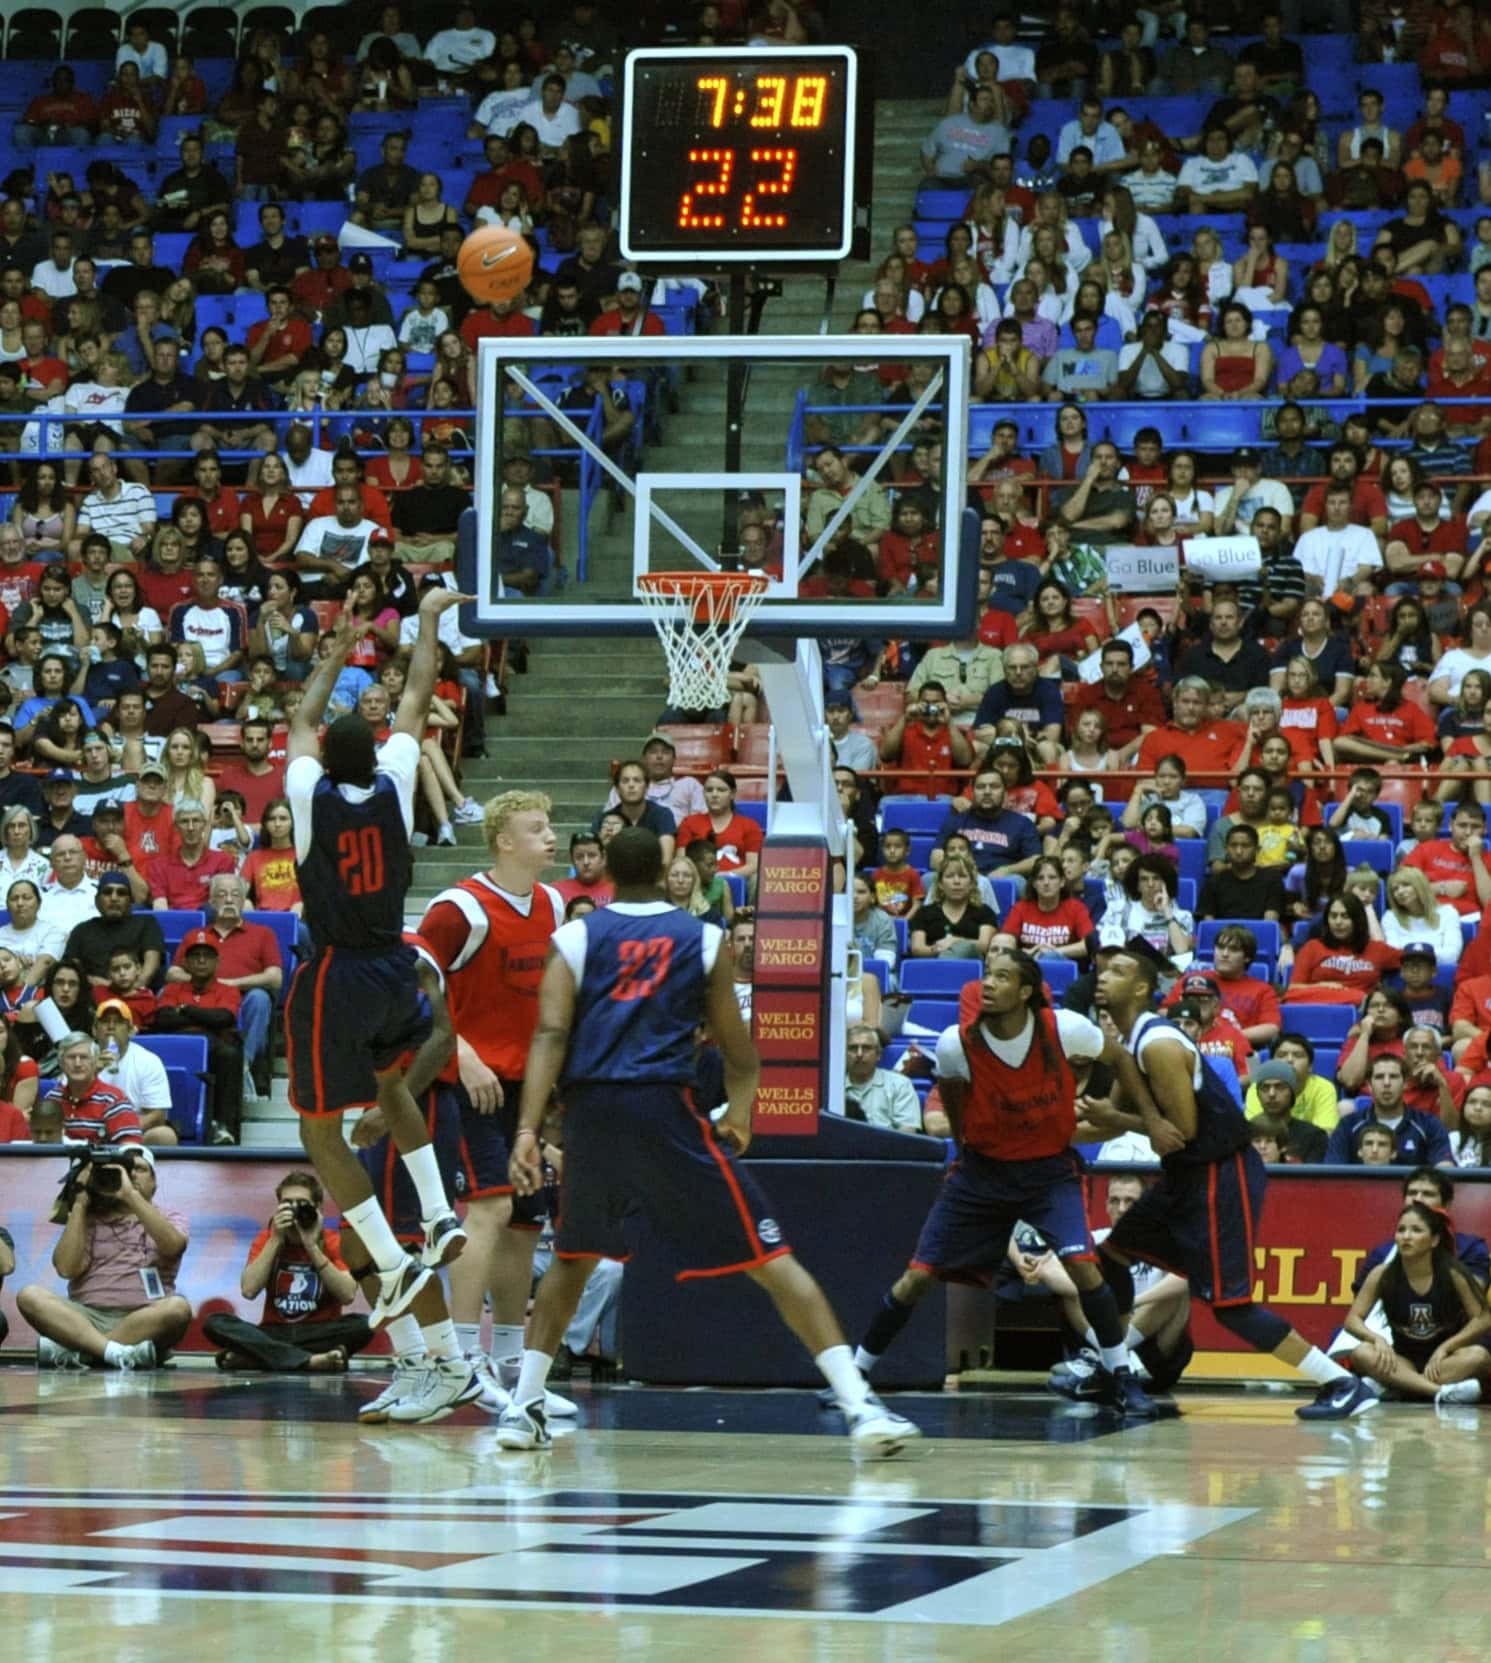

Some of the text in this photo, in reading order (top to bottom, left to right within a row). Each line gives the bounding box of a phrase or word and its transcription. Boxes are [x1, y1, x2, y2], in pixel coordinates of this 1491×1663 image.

[697, 77, 827, 128] 7:38
[678, 149, 797, 228] 22
[1188, 548, 1257, 567] Go Blue
[1109, 559, 1176, 575] Go Blue
[337, 826, 385, 896] 20
[764, 866, 822, 880] WELLS
[764, 881, 820, 894] FARGO
[760, 939, 818, 952] WELLS
[760, 953, 817, 966] FARGO
[758, 1012, 816, 1025] WELLS
[758, 1027, 815, 1040] FARGO
[756, 1087, 814, 1101] WELLS
[758, 1102, 813, 1115] FARGO
